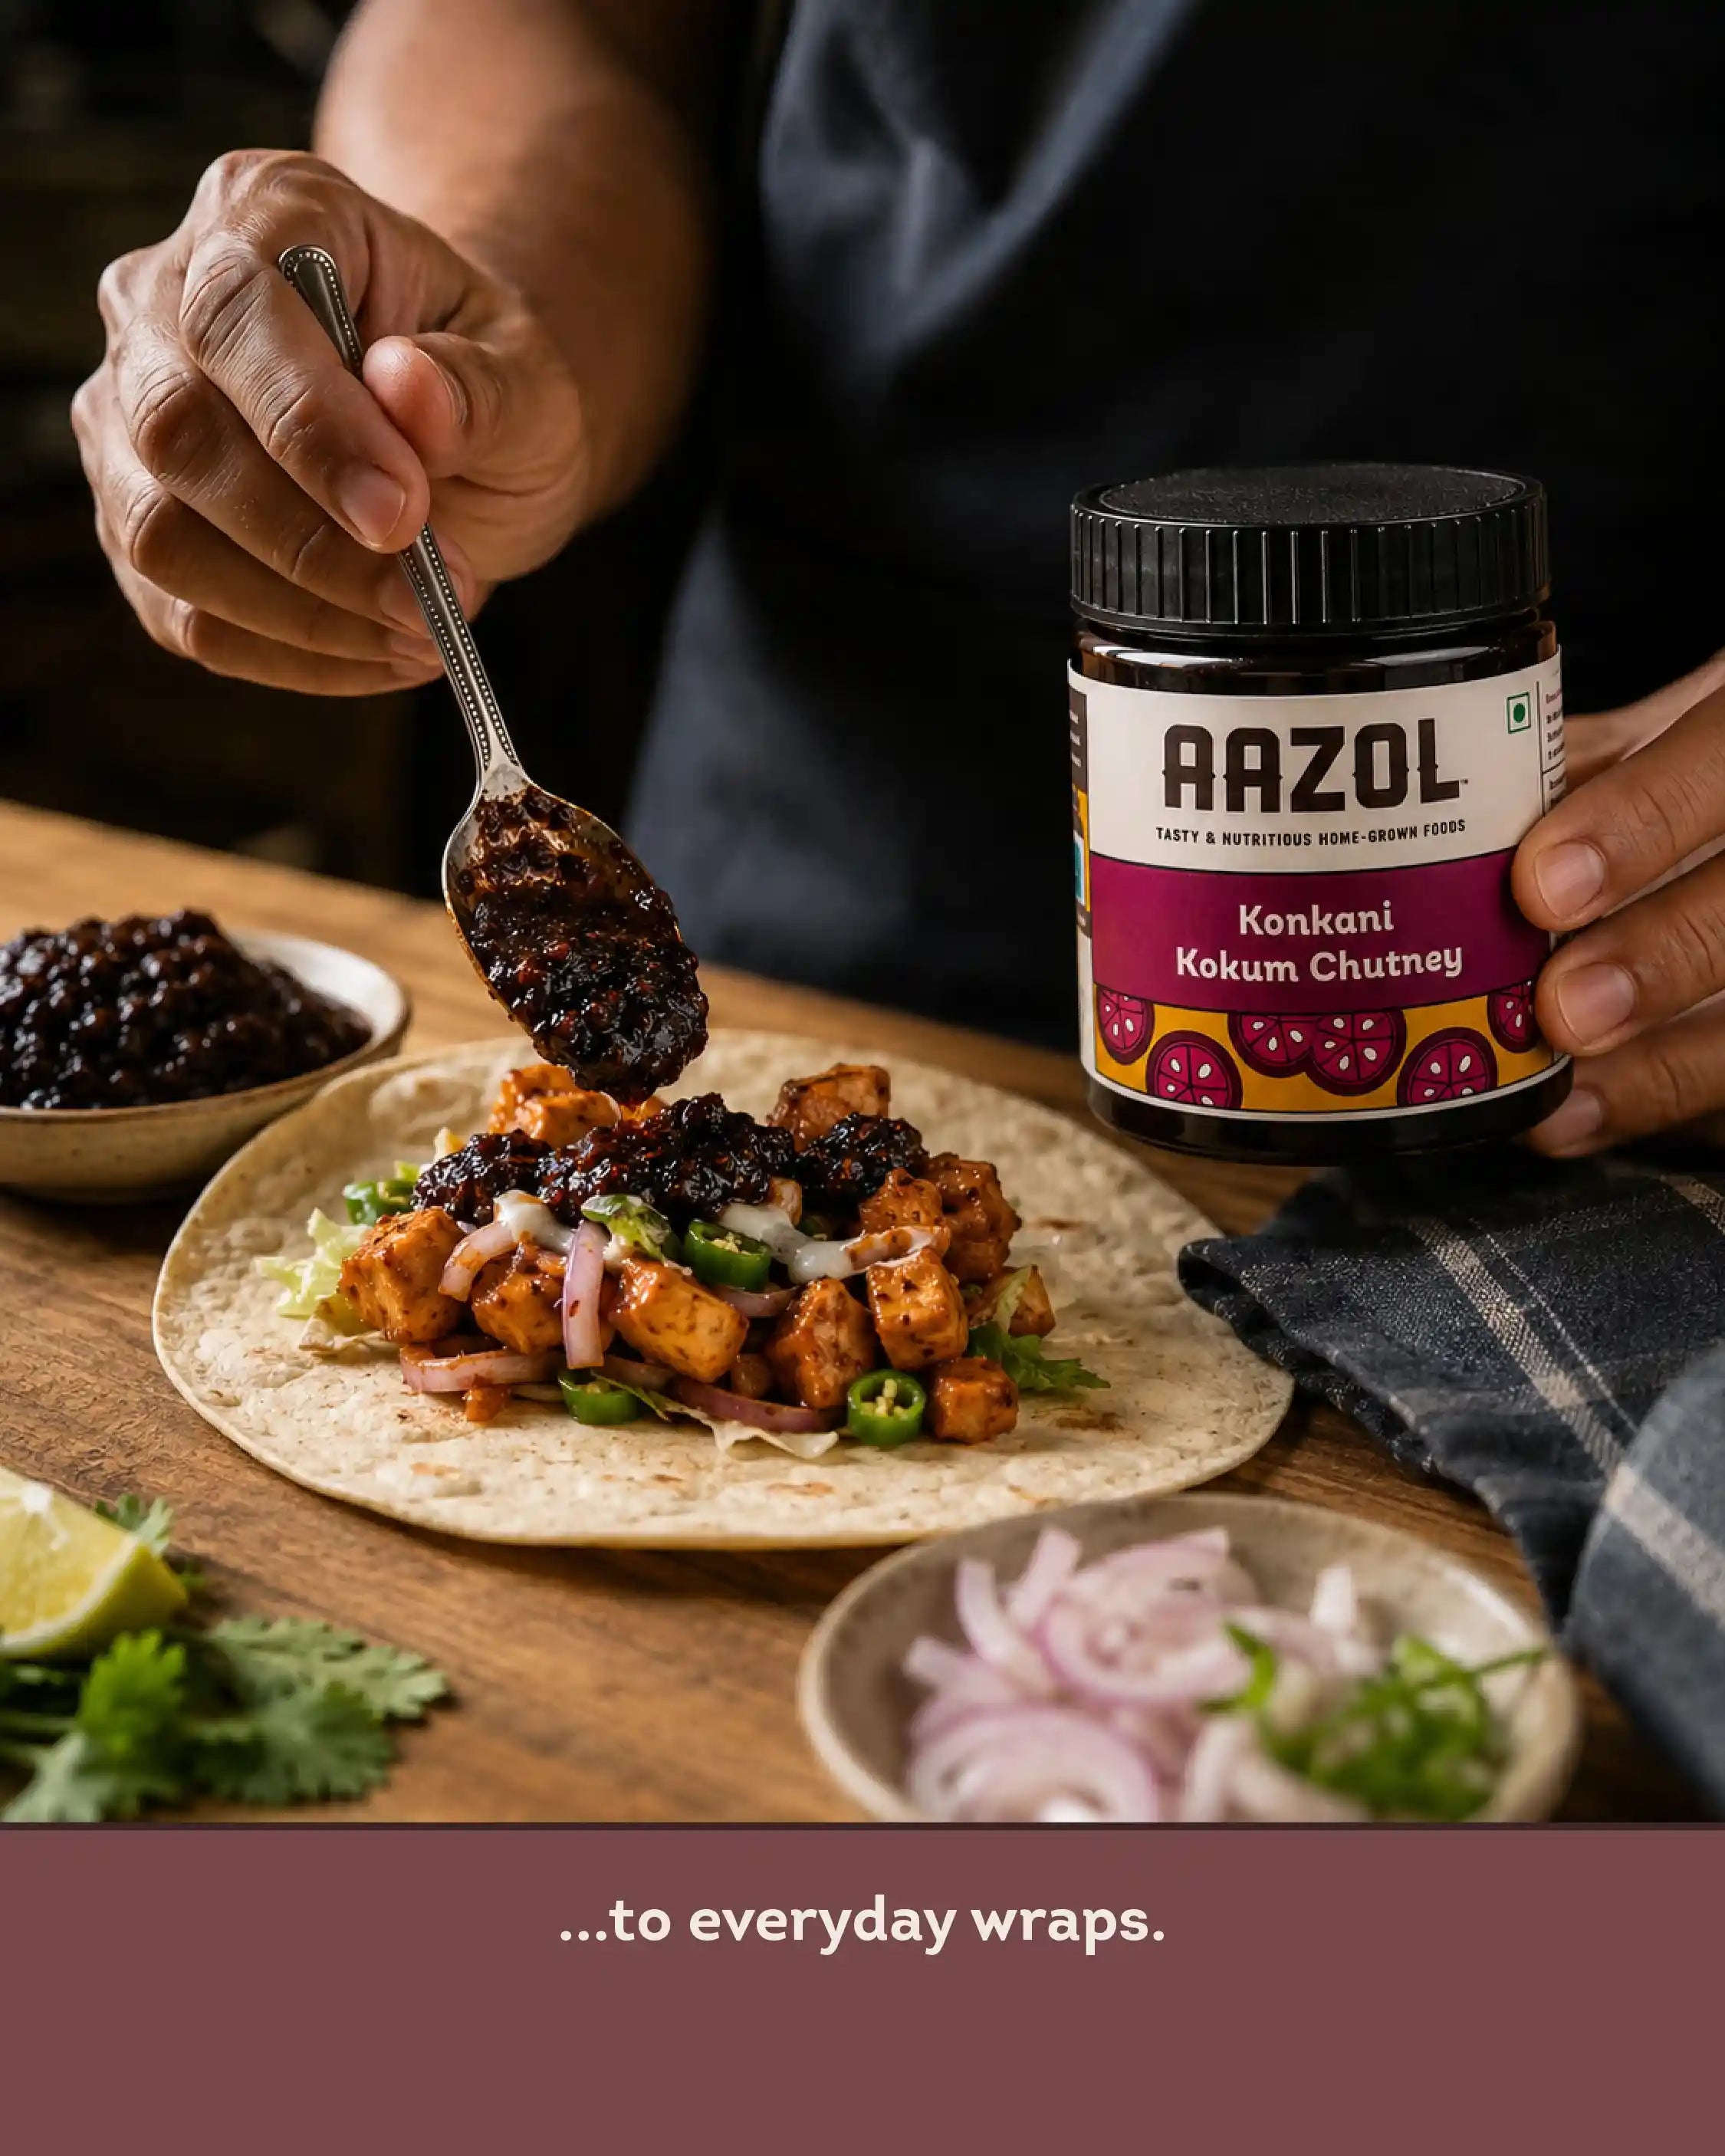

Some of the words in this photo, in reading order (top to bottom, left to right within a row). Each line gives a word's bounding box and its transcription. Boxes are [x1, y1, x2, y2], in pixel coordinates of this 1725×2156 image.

[1162, 718, 1460, 813] AAZOL
[1155, 827, 1199, 843] TASTY
[1205, 830, 1216, 845] &
[1222, 832, 1313, 847] NUTRITIOUS
[1319, 825, 1418, 846] HOME-GROWN
[1423, 818, 1466, 838] FOODS
[1239, 899, 1395, 935] Konkani
[1176, 946, 1299, 982] Kokum
[1309, 946, 1463, 981] Chutney
